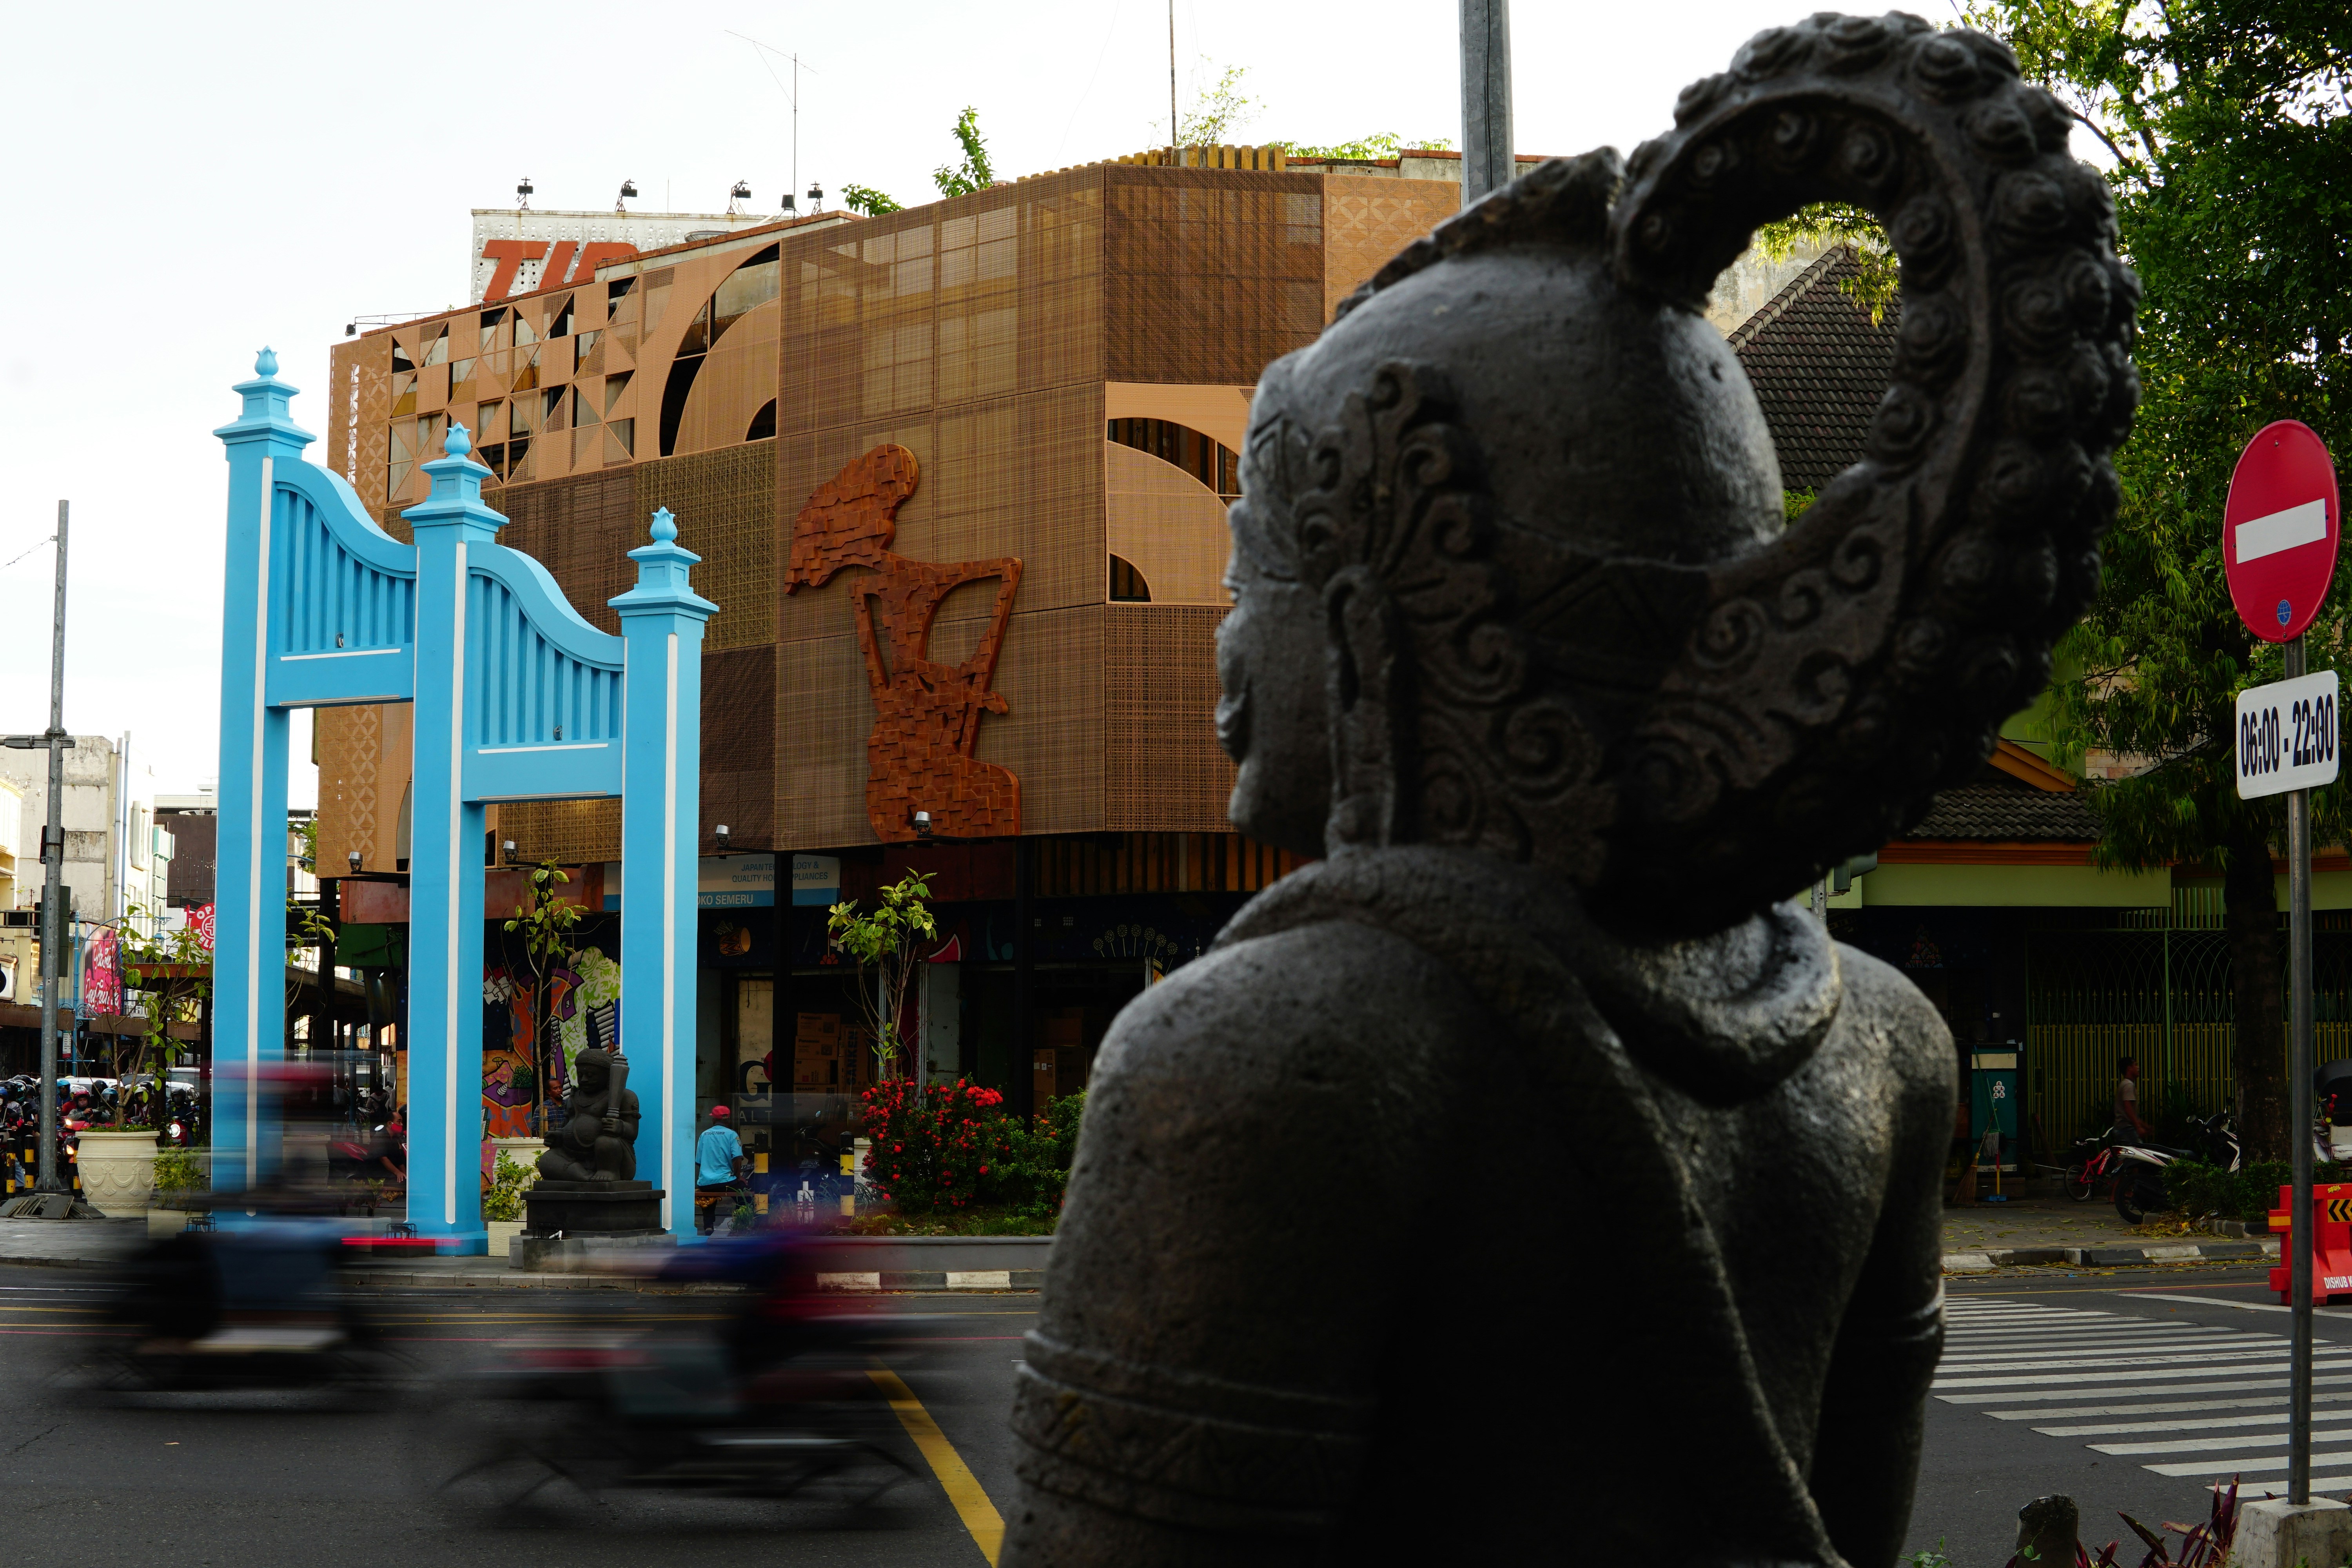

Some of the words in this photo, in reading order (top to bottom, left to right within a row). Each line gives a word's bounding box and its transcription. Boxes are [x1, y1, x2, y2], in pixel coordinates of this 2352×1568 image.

[2241, 706, 2279, 777] 06:00
[2284, 738, 2288, 752] -
[2292, 693, 2334, 767] 22:00
[698, 895, 713, 905] KO
[715, 894, 753, 905] SEMERU
[847, 1031, 858, 1085] SANKEN
[2323, 1276, 2348, 1289] DISHUB
